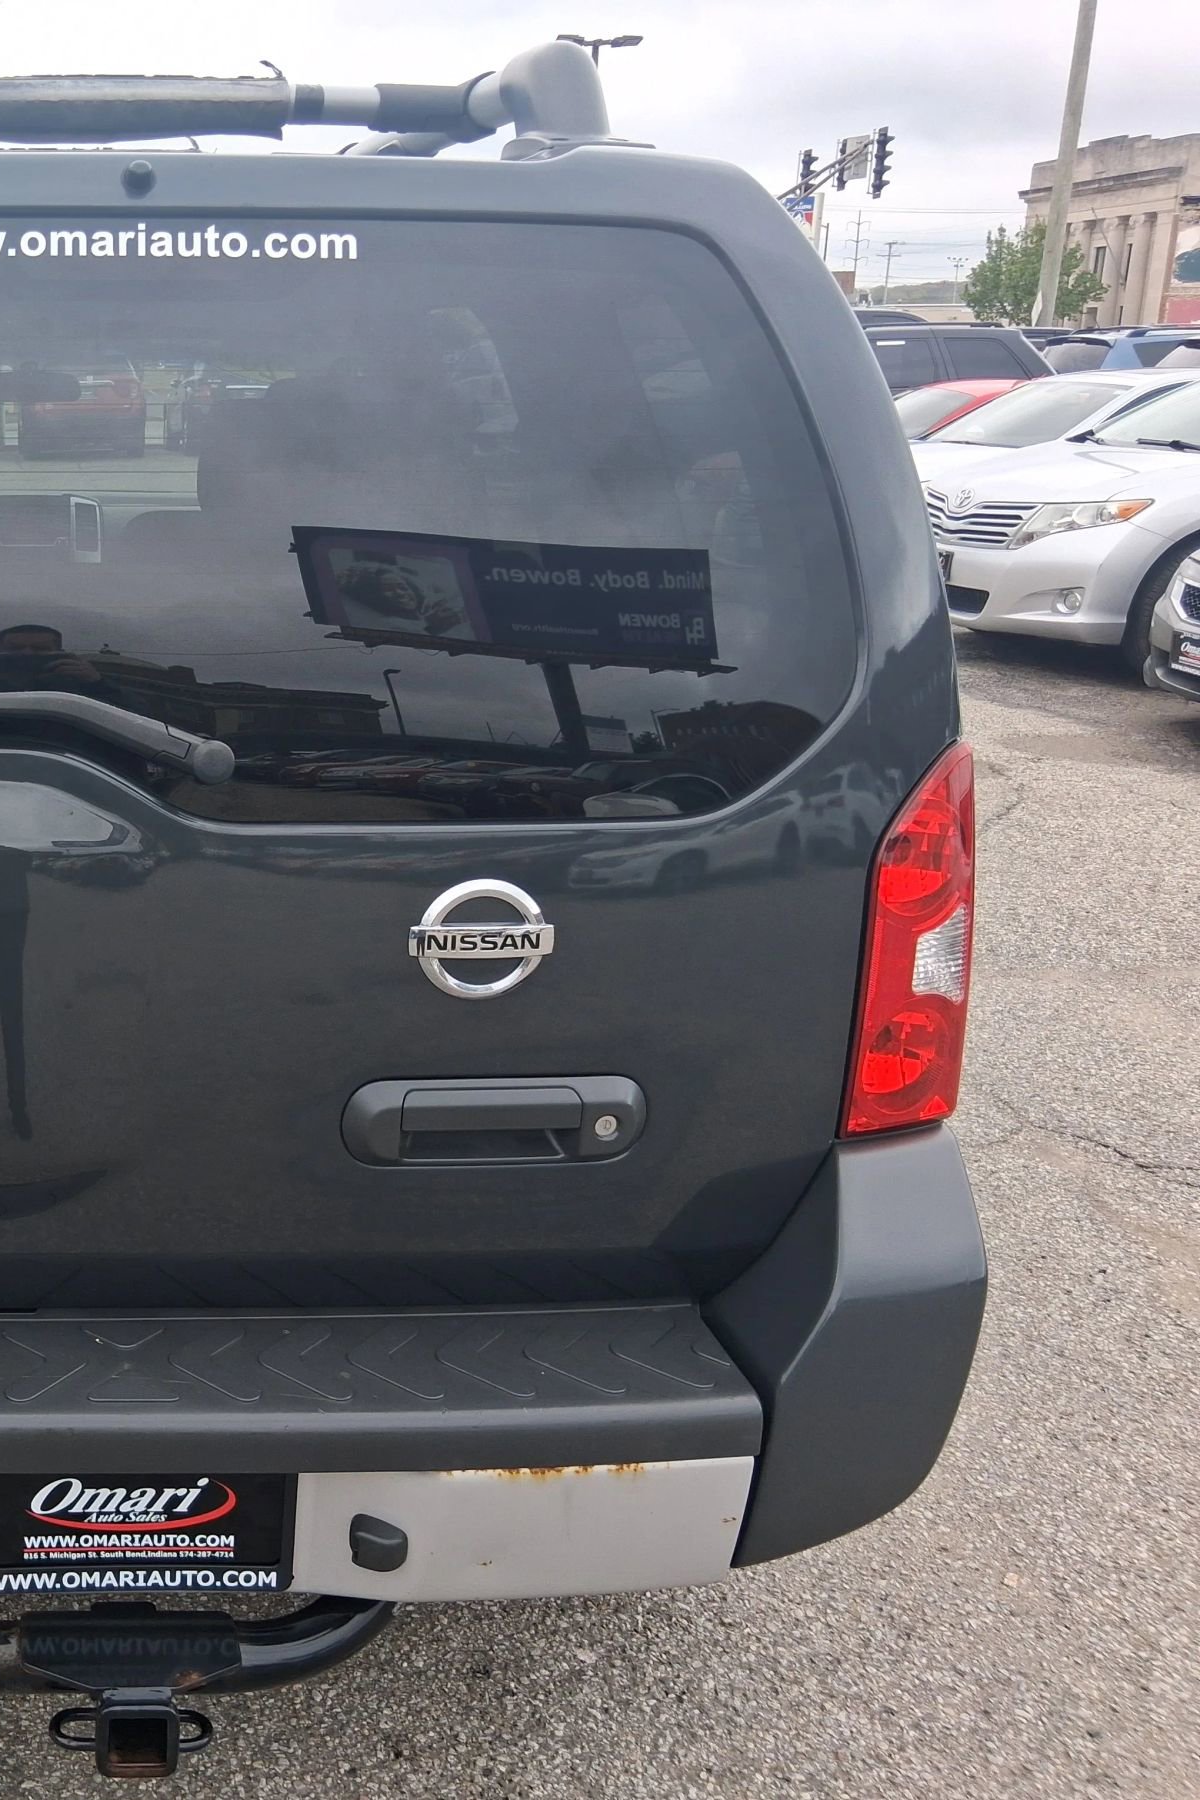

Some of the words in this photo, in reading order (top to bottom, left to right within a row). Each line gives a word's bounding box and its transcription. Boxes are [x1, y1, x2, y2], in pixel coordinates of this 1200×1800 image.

[426, 933, 541, 951] NISSAN
[30, 1477, 211, 1515] Omari
[84, 1511, 124, 1524] Auto
[127, 1511, 168, 1524] Sales
[23, 1534, 236, 1549] WWW.OMARIAUTO.COM
[40, 1552, 48, 1560] S.
[49, 1551, 86, 1562] Michigan
[87, 1551, 99, 1560] St.
[100, 1551, 125, 1560] South
[179, 1551, 235, 1560] 574-287-4714
